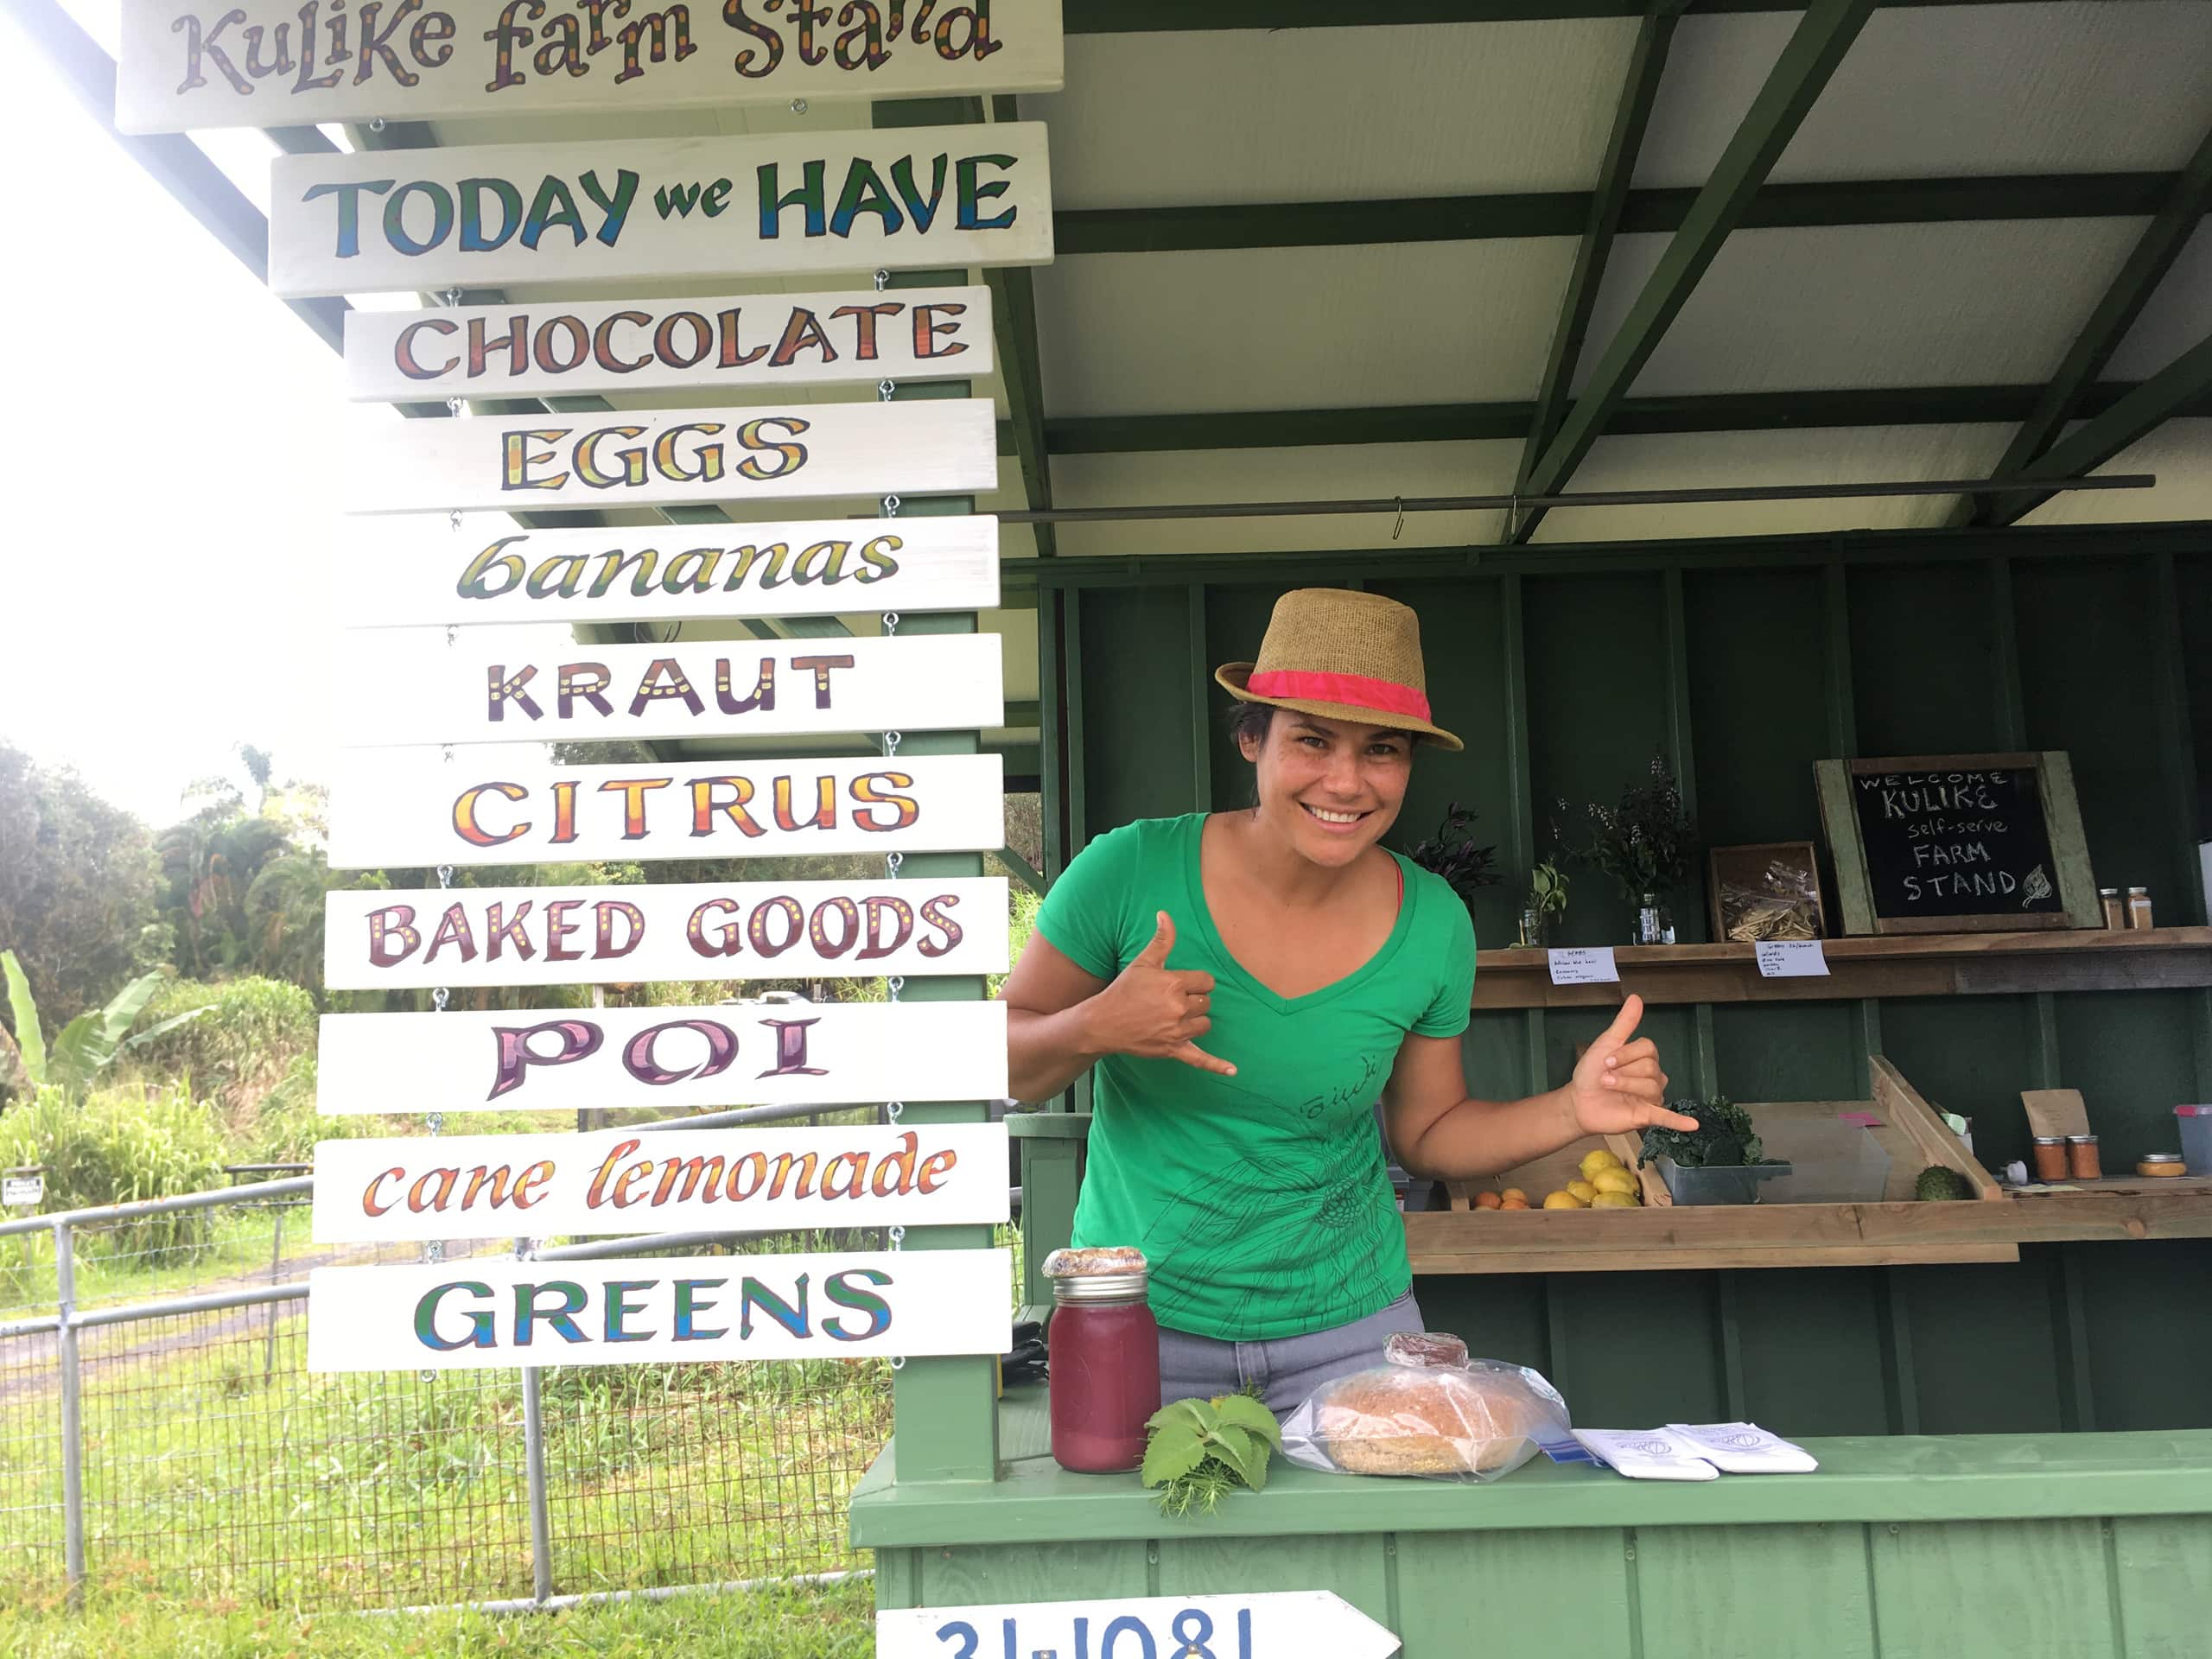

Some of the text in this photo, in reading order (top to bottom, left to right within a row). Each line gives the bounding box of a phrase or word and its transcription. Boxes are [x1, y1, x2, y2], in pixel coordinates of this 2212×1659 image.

[302, 153, 1019, 257] TODAY we HAVE
[395, 302, 969, 380] CHOCOLATE
[499, 416, 810, 491] EGGS
[456, 534, 904, 600] bananas
[487, 654, 855, 722] KRAUT
[452, 772, 919, 848] CITRUS
[1859, 772, 2009, 790] WELCOME
[1881, 784, 1999, 819] KULIKE
[1907, 817, 2009, 839] self-serve
[1913, 841, 1992, 868] FARM
[1903, 870, 2017, 901] STAND
[365, 894, 963, 968] BAKED GOODS
[486, 1017, 830, 1101] POI
[362, 1131, 957, 1217] cane lemonade
[414, 1269, 893, 1351] GREENS
